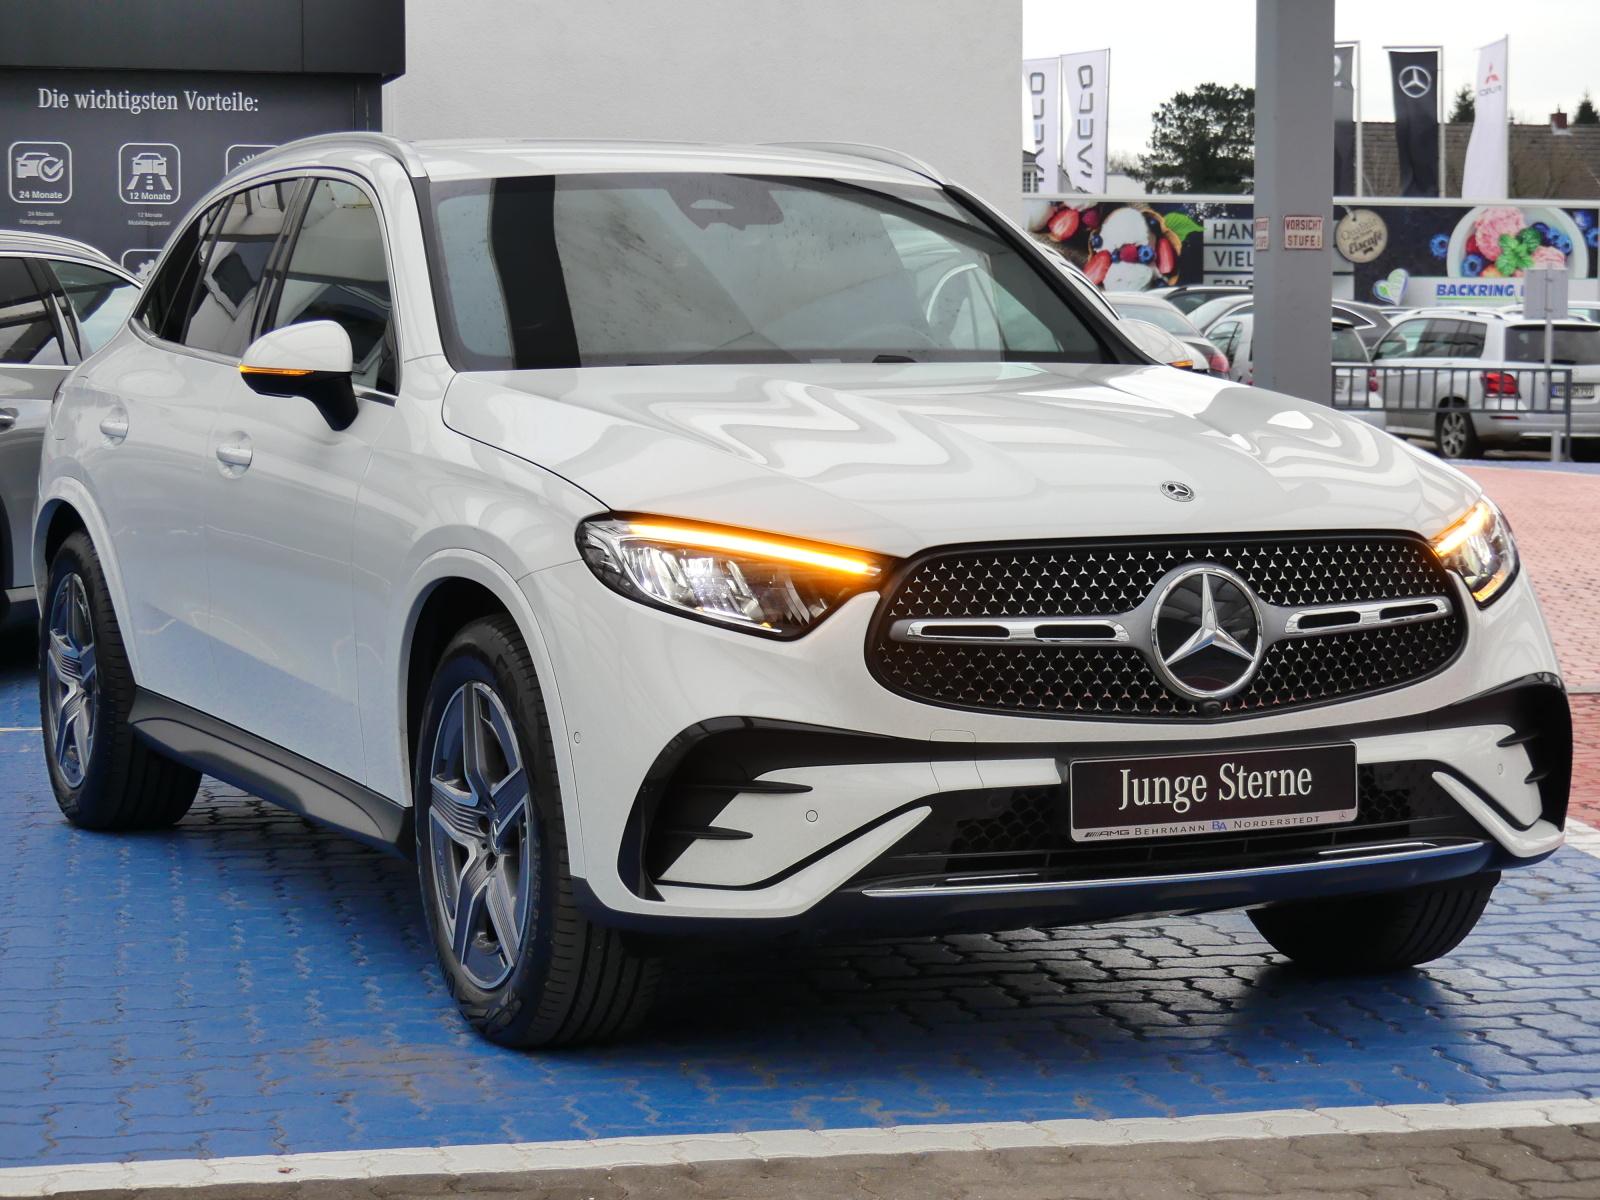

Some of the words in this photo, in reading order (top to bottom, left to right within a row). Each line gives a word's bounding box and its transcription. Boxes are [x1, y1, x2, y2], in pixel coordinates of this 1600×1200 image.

[38, 88, 69, 109] Die
[74, 90, 178, 114] wichtigsten
[184, 91, 259, 112] Vorteile:
[18, 190, 30, 199] 24
[31, 190, 63, 199] Monate
[129, 192, 139, 200] 12
[141, 192, 171, 201] Monate
[1285, 220, 1322, 231] VORSICHT
[1436, 284, 1515, 297] BACKRING
[1118, 768, 1208, 814] Junge
[1218, 762, 1313, 801] Sterne
[1098, 828, 1131, 838] AMG
